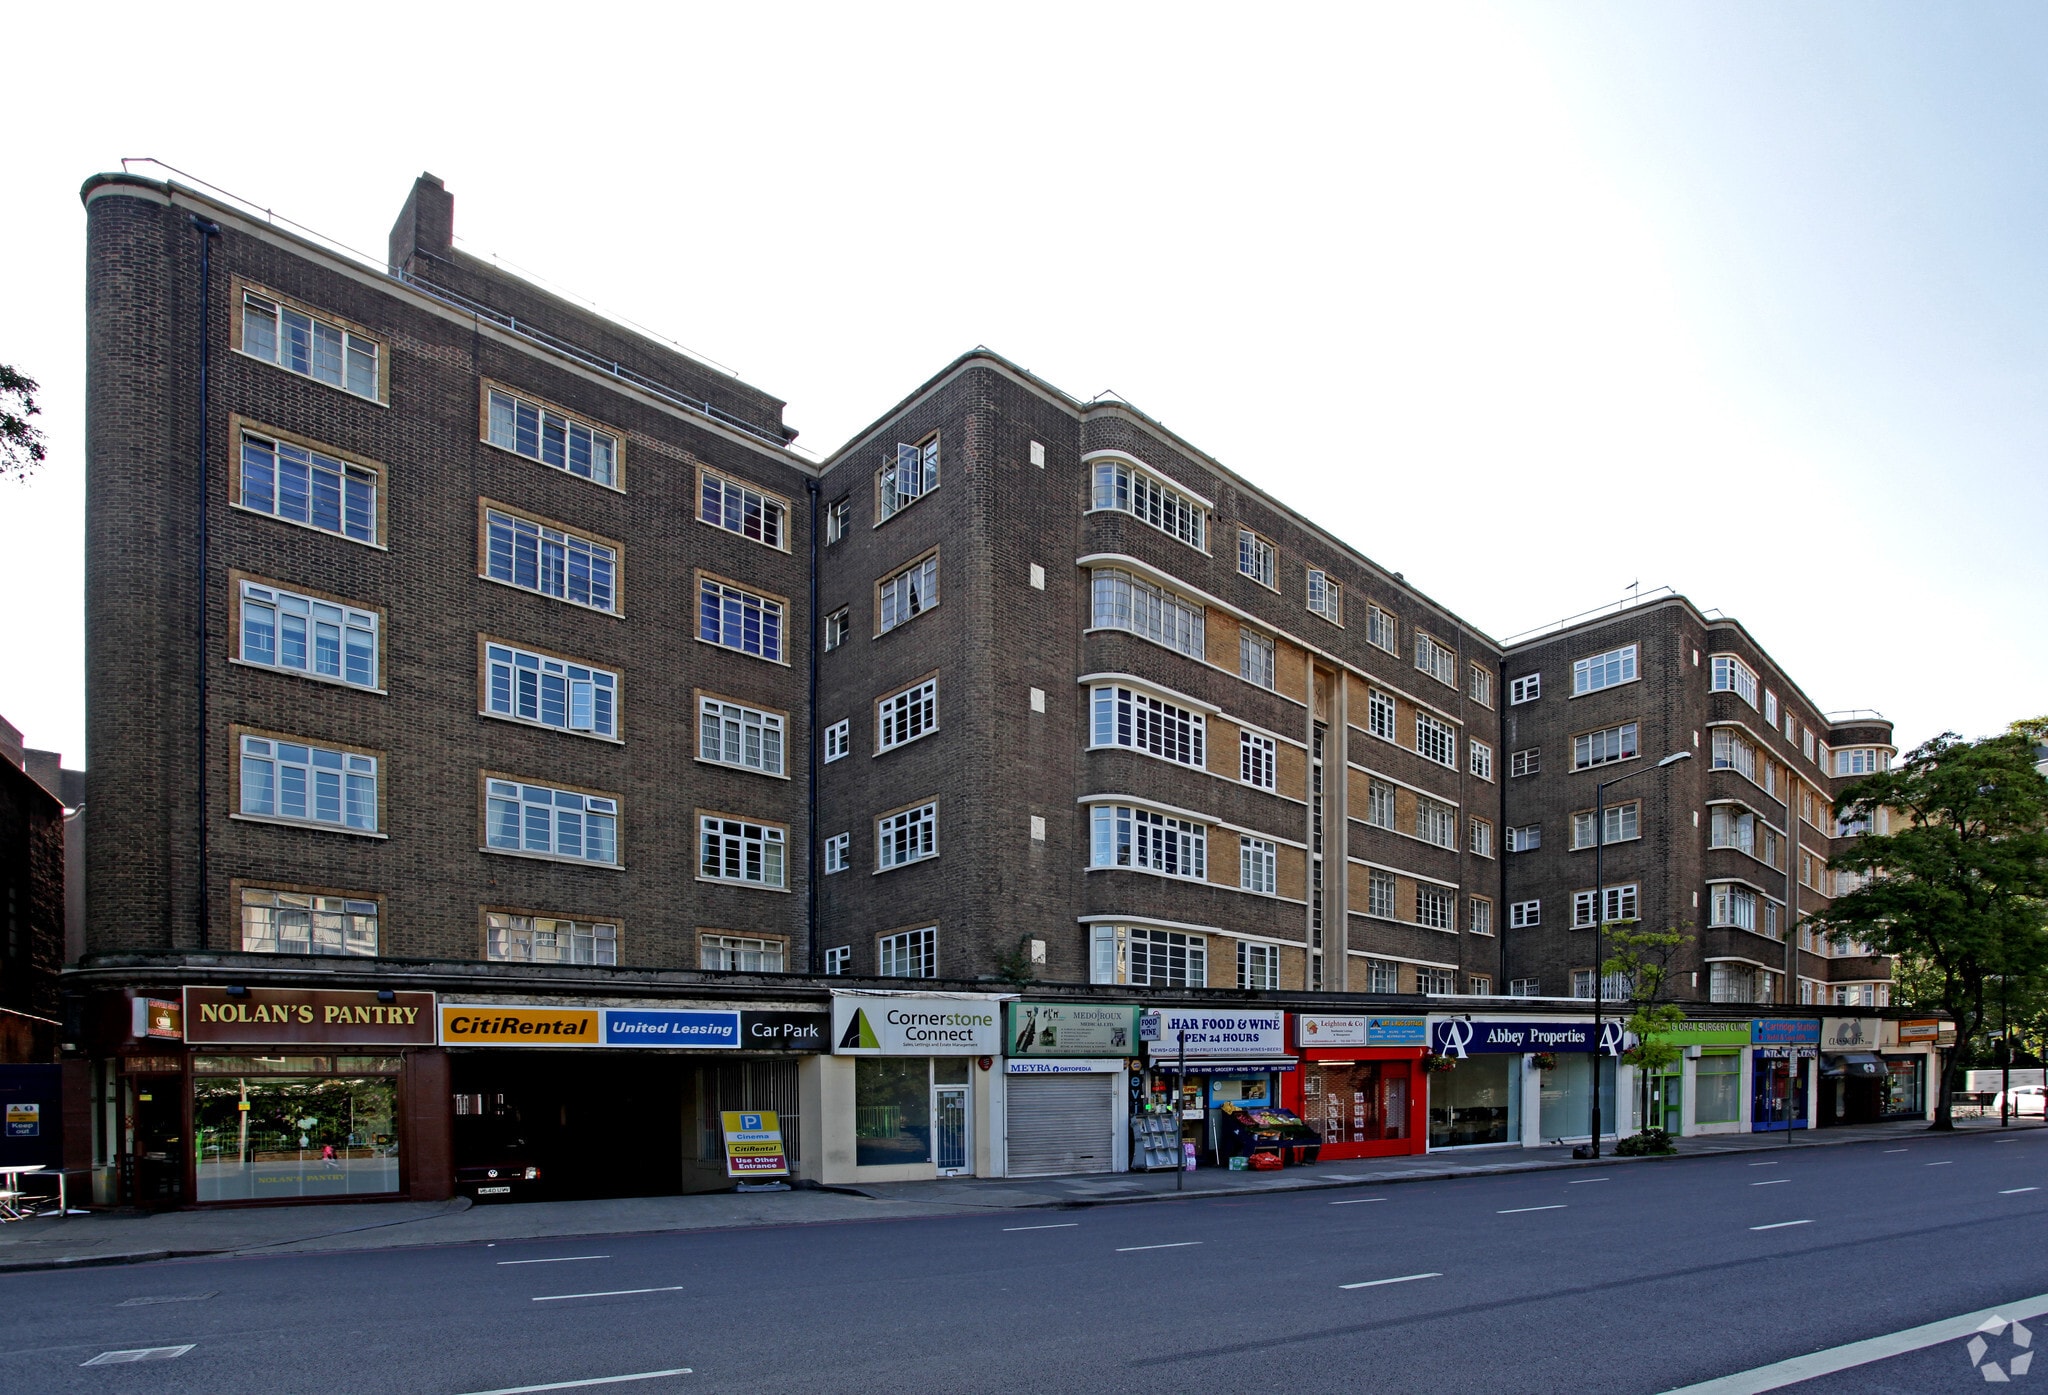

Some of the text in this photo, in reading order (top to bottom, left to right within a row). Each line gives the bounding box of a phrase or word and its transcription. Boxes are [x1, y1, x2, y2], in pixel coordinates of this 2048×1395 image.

[200, 1003, 419, 1025] NOLAN'S PANTRY
[887, 1009, 993, 1026] Cornerstone
[450, 1016, 588, 1036] CitiRental
[1141, 1018, 1158, 1026] FOOD
[1202, 1018, 1231, 1030] FOOD
[1237, 1019, 1247, 1030] &
[1249, 1019, 1281, 1030] WINE
[1678, 1022, 1696, 1031] ORAL
[1699, 1022, 1728, 1031] SURGERY
[1730, 1022, 1749, 1031] CLINIC
[1765, 1021, 1818, 1033] Cartridge Station
[612, 1021, 733, 1037] United Leasing
[751, 1023, 819, 1038] Car Park
[905, 1026, 973, 1041] Connect
[1141, 1028, 1157, 1036] WINE
[1209, 1034, 1221, 1043] 24
[1222, 1033, 1260, 1043] HOURS
[1487, 1028, 1586, 1046] Abbey Properties
[1010, 1064, 1051, 1072] MEYRA
[744, 1116, 757, 1129] P
[258, 1173, 347, 1183] NOLAN'S PANTRY
